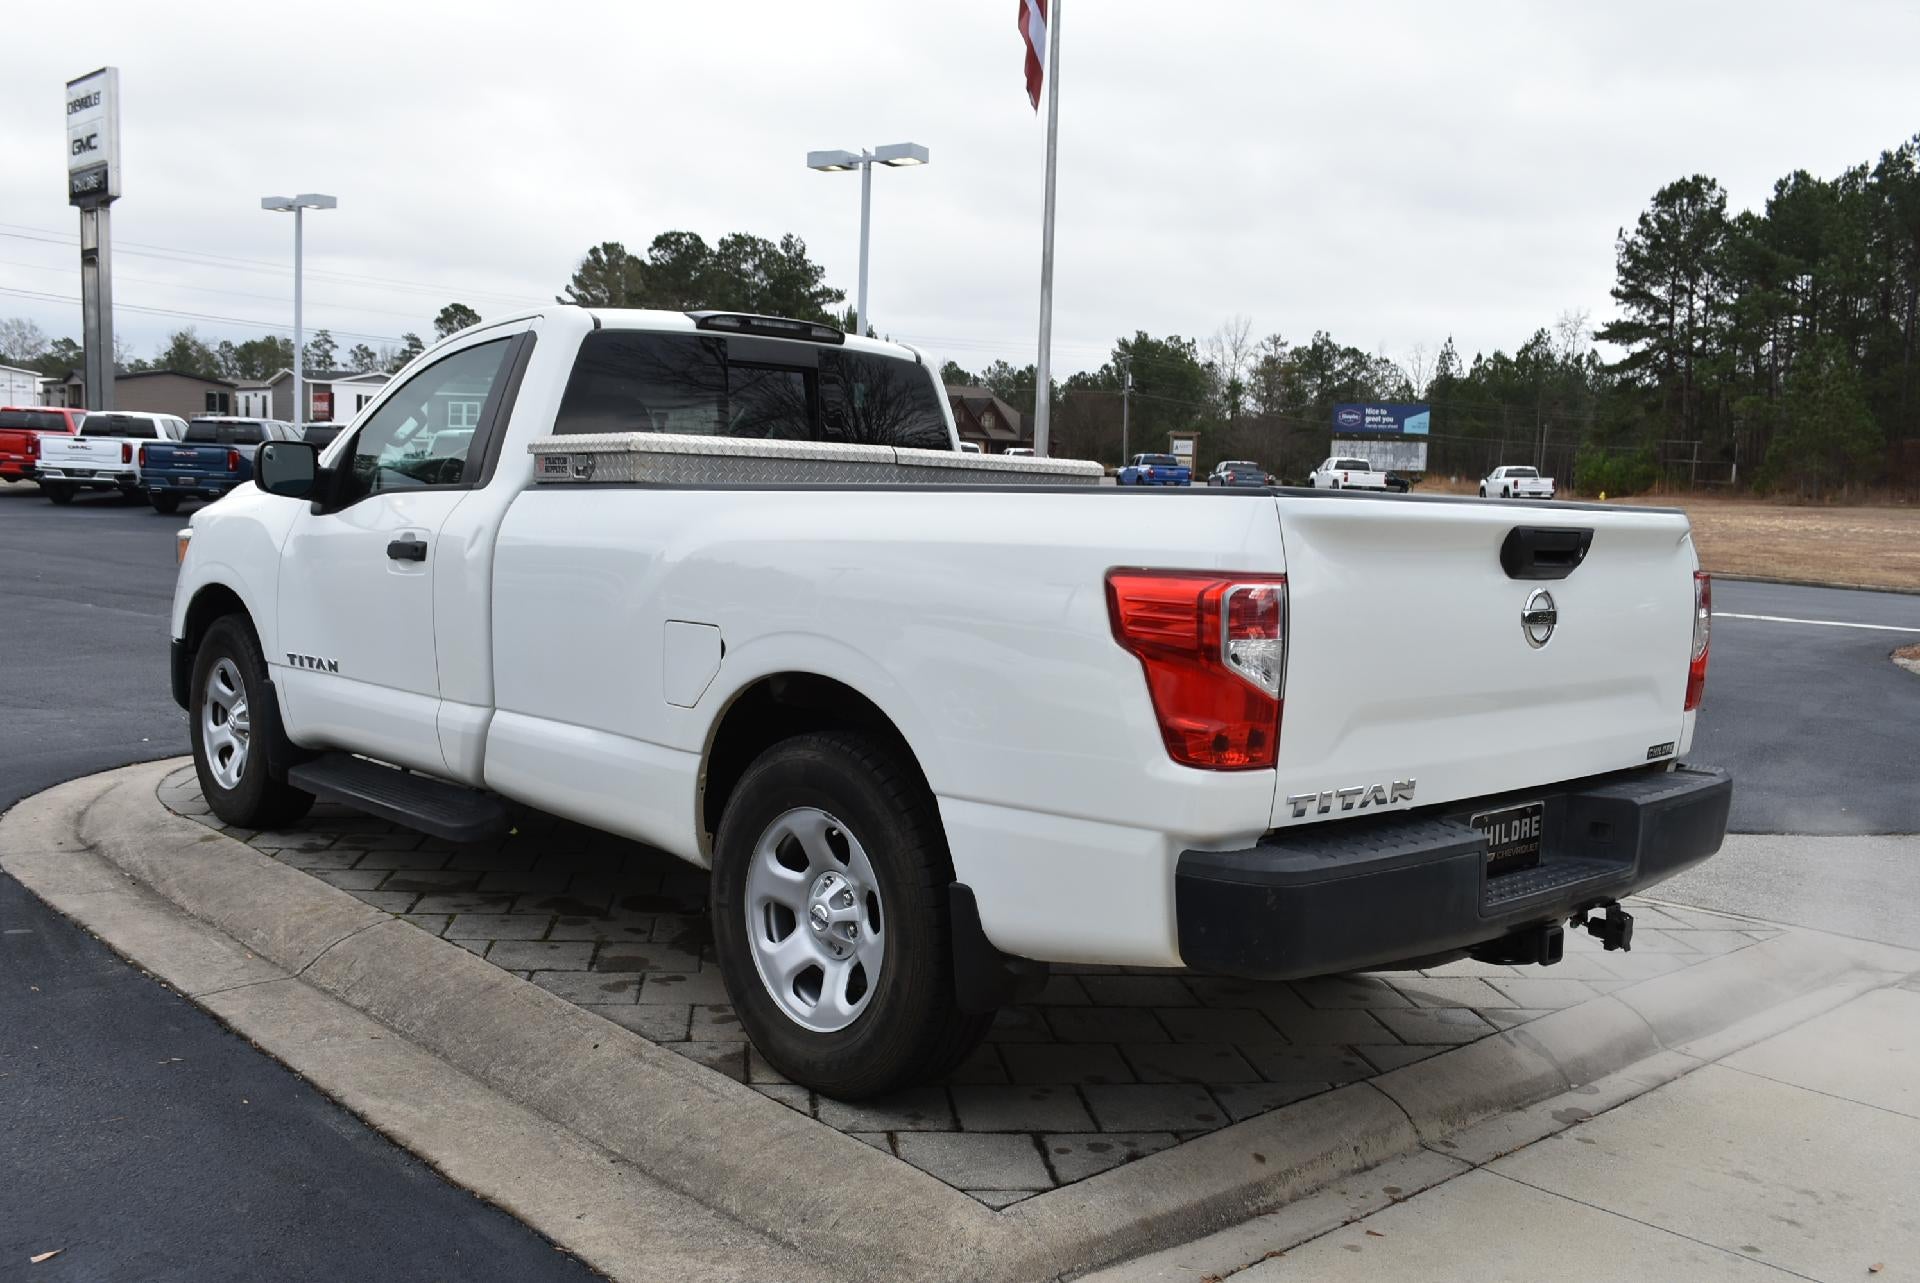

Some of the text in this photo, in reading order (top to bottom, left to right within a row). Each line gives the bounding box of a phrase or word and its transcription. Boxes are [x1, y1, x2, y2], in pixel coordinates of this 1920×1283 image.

[73, 133, 97, 155] GMC
[286, 651, 339, 673] TITAN
[1287, 778, 1416, 818] TITAN
[1484, 815, 1540, 846] HILDRE
